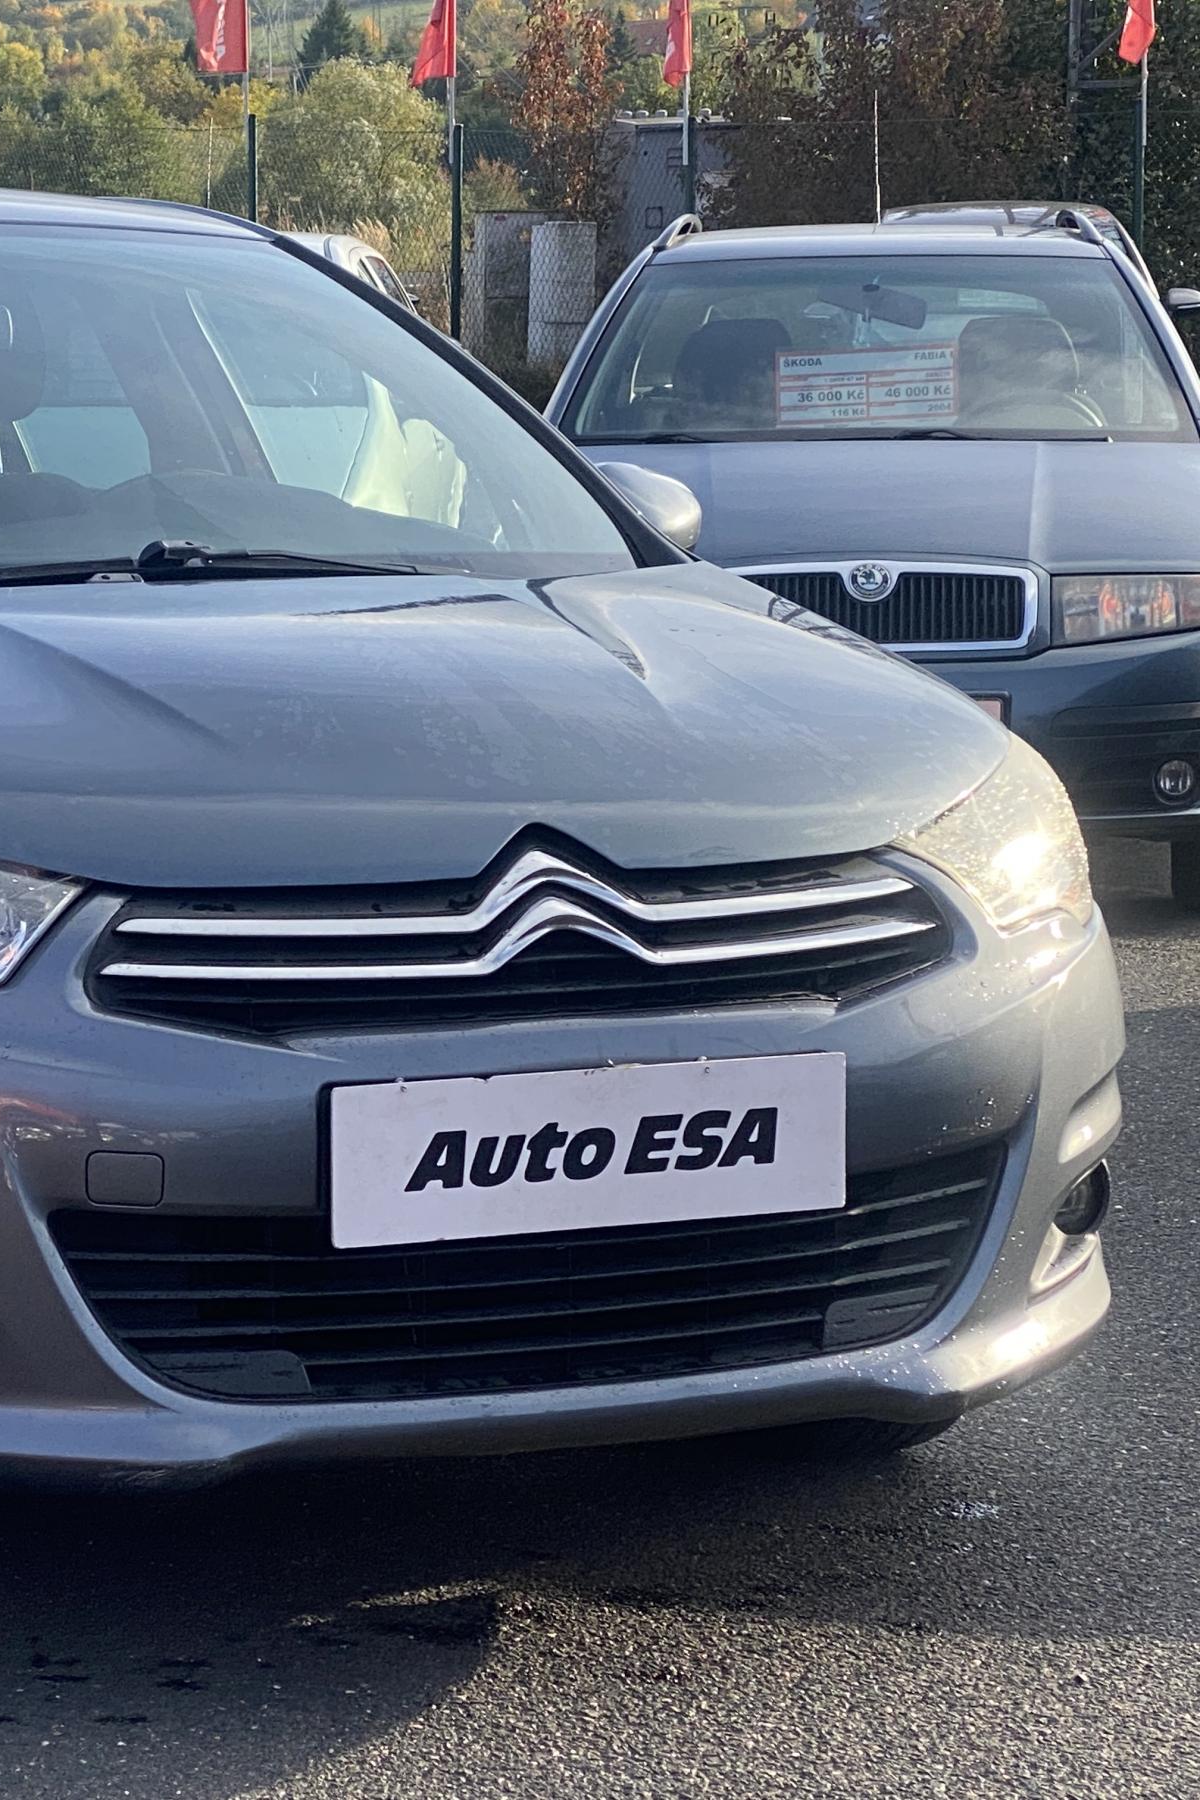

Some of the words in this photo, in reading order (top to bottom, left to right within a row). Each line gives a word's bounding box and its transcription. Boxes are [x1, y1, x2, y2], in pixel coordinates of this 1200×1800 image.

[797, 392, 814, 403] 36
[818, 391, 843, 402] 000
[847, 389, 865, 401] Kč
[884, 387, 901, 398] 46
[905, 386, 929, 397] 000
[934, 384, 951, 396] Kč
[404, 1122, 616, 1192] Auto
[624, 1107, 779, 1175] ESA
